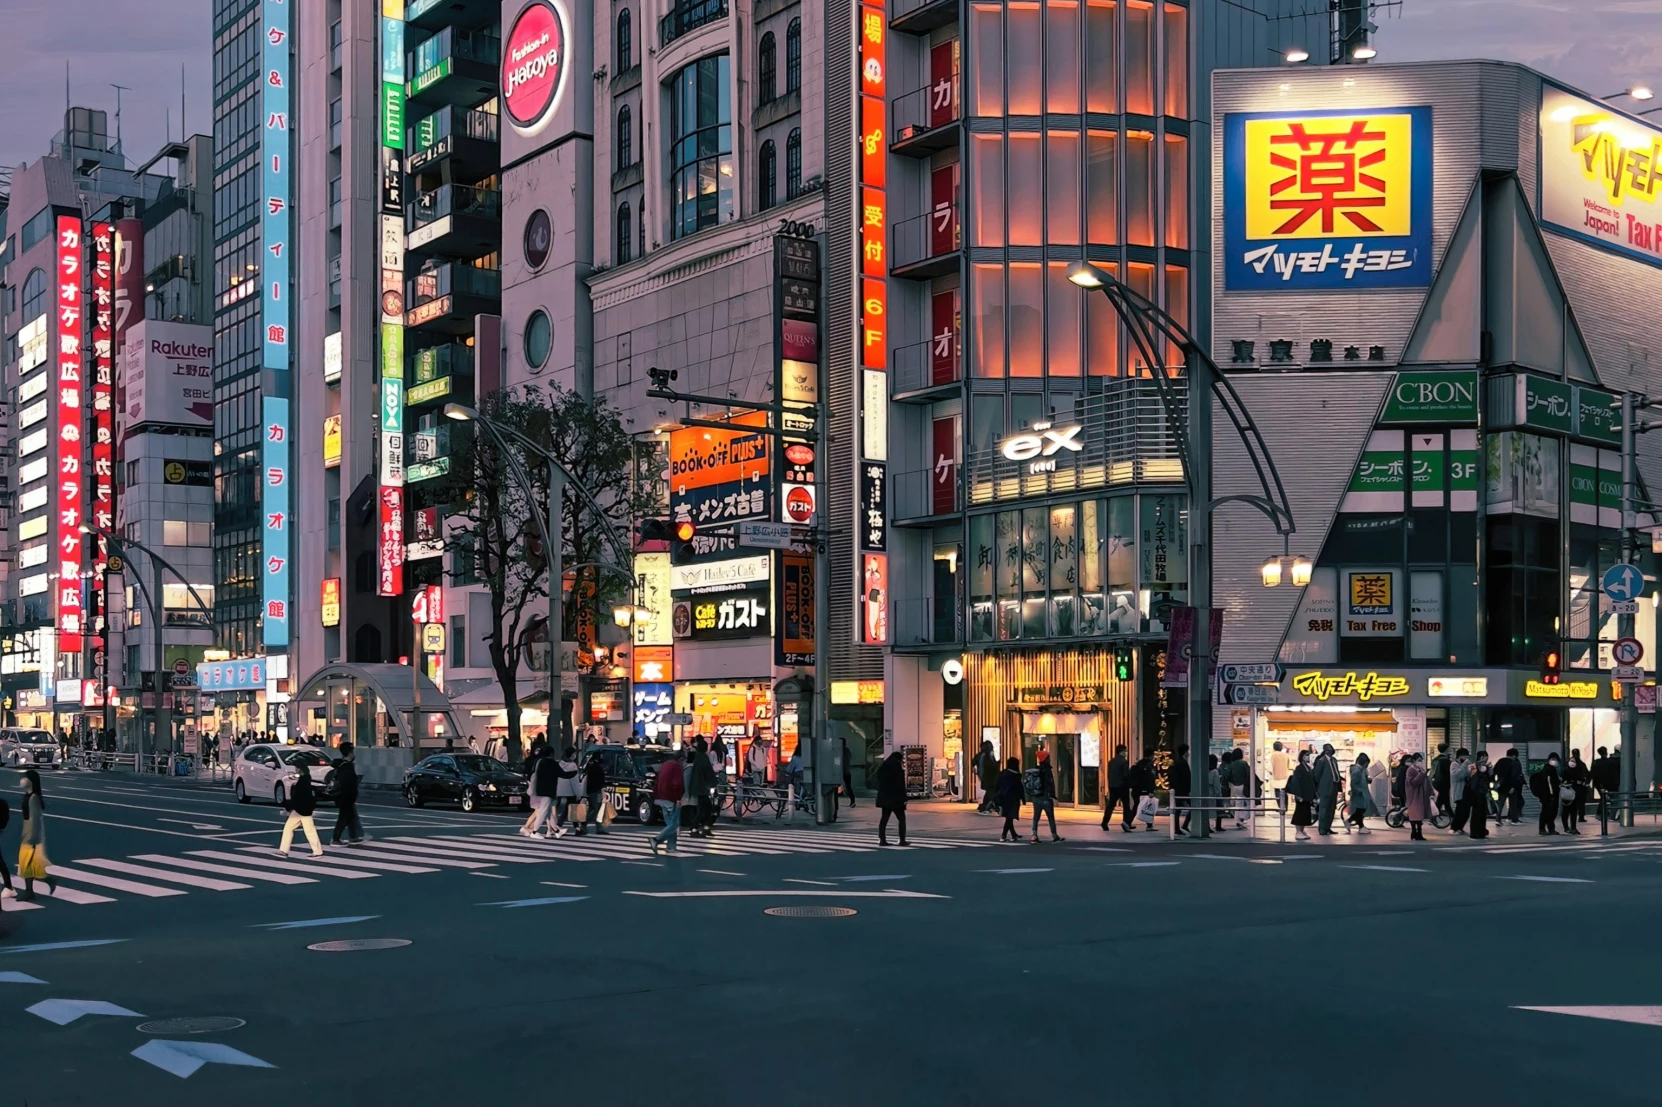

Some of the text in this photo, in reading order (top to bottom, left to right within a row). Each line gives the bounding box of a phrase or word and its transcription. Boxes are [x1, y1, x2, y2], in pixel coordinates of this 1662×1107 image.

[505, 48, 559, 98] Hatoya
[1270, 121, 1386, 235] 薬
[1583, 197, 1620, 219] Welcome to
[1584, 210, 1620, 237] Japan!
[1626, 213, 1652, 251] Tax
[864, 205, 883, 346] 受付 6F
[1244, 243, 1413, 280] マツモトキヨシ
[60, 229, 80, 409] カラオケ歌広場
[172, 363, 214, 377] 上野広
[183, 388, 213, 400] 宮田ビ
[386, 382, 399, 427] NOVA
[1396, 382, 1474, 404] C'BON
[1003, 425, 1085, 460] ex
[165, 462, 185, 482] 占
[1452, 463, 1475, 478] 3F
[267, 424, 286, 618] カラオケ館
[789, 501, 811, 512] ガスト
[60, 454, 80, 634] カラオケ歌広場
[1356, 576, 1386, 605] 薬
[695, 604, 716, 620] Café
[718, 598, 766, 630] ガスト
[1308, 619, 1333, 632] 免税
[1347, 619, 1442, 633] Tax Free Shop
[634, 691, 673, 707] ゲーム
[1294, 671, 1410, 700] マツモトキヨシ
